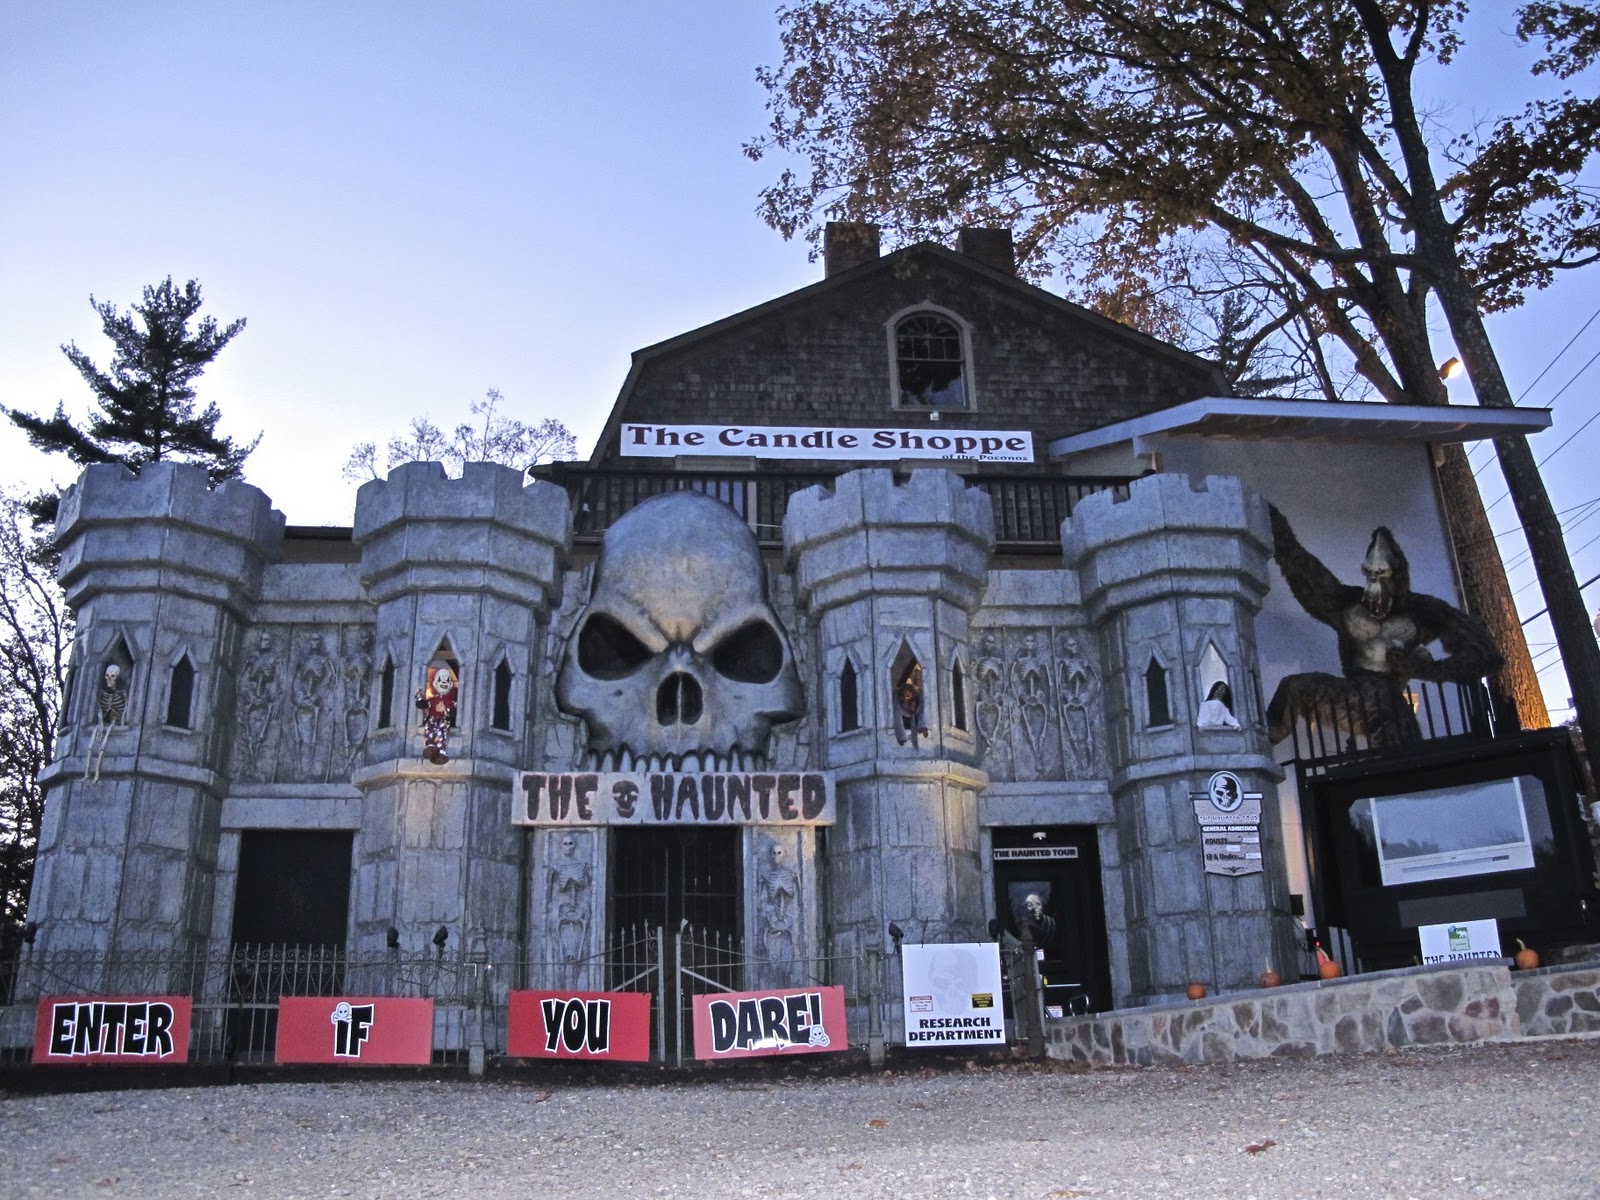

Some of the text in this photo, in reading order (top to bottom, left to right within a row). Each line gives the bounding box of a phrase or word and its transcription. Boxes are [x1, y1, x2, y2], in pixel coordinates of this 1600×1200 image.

[627, 425, 1027, 454] The Candle Shoppe
[522, 774, 827, 820] THE HAUNTED
[1012, 849, 1051, 857] HAUNTED
[1424, 951, 1501, 966] THE HAUNTED
[49, 1002, 174, 1058] ENTER
[541, 998, 611, 1053] YOU
[709, 992, 829, 1053] DARE!
[908, 1029, 1002, 1041] DEPARTMENT
[919, 1017, 991, 1028] RESEARCH
